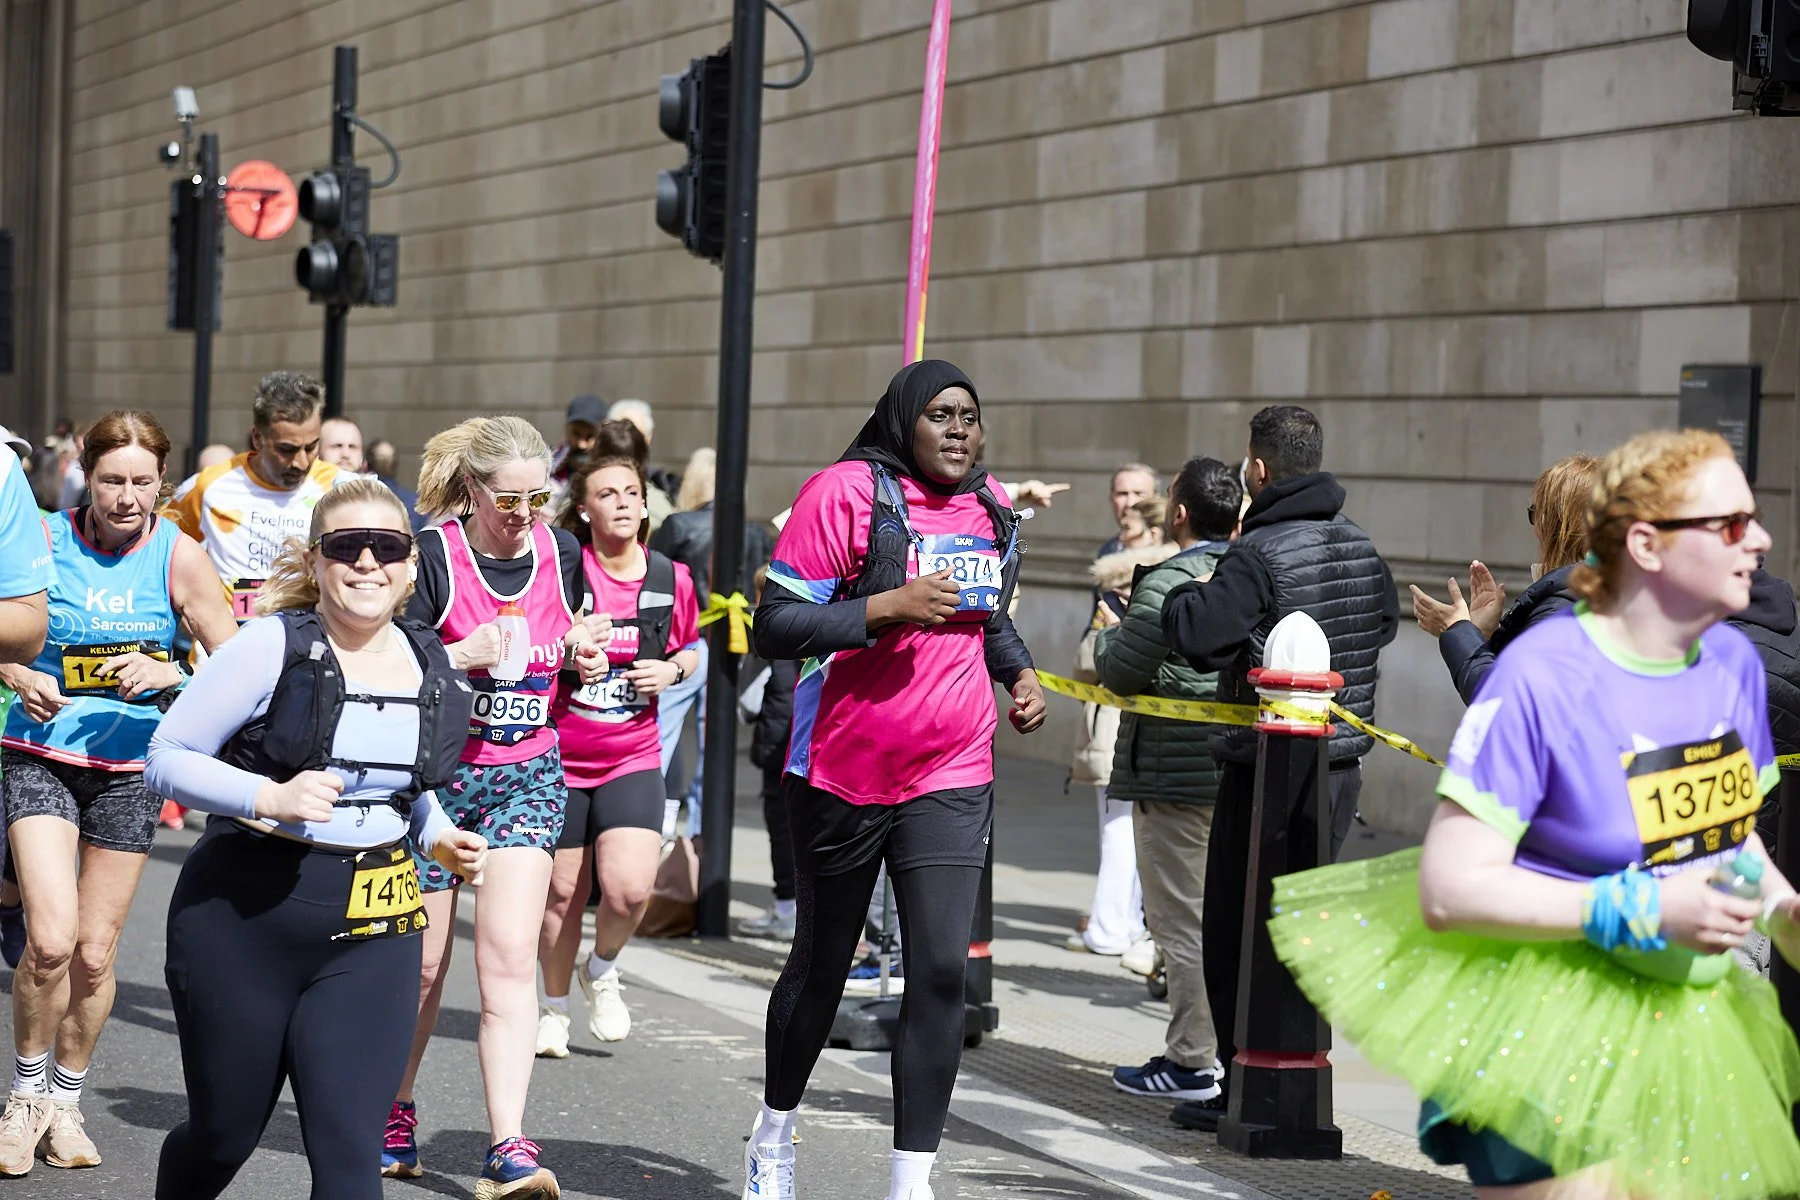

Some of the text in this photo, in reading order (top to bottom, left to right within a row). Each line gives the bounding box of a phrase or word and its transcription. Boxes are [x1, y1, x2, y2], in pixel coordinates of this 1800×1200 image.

[251, 511, 305, 528] Evelina
[85, 586, 135, 614] Kel
[90, 643, 141, 655] KELLY-ANN
[495, 680, 516, 688] CATH
[587, 681, 638, 702] 9145
[473, 693, 541, 722] 0956
[1683, 740, 1723, 763] EMILY
[1647, 762, 1753, 824] 13798
